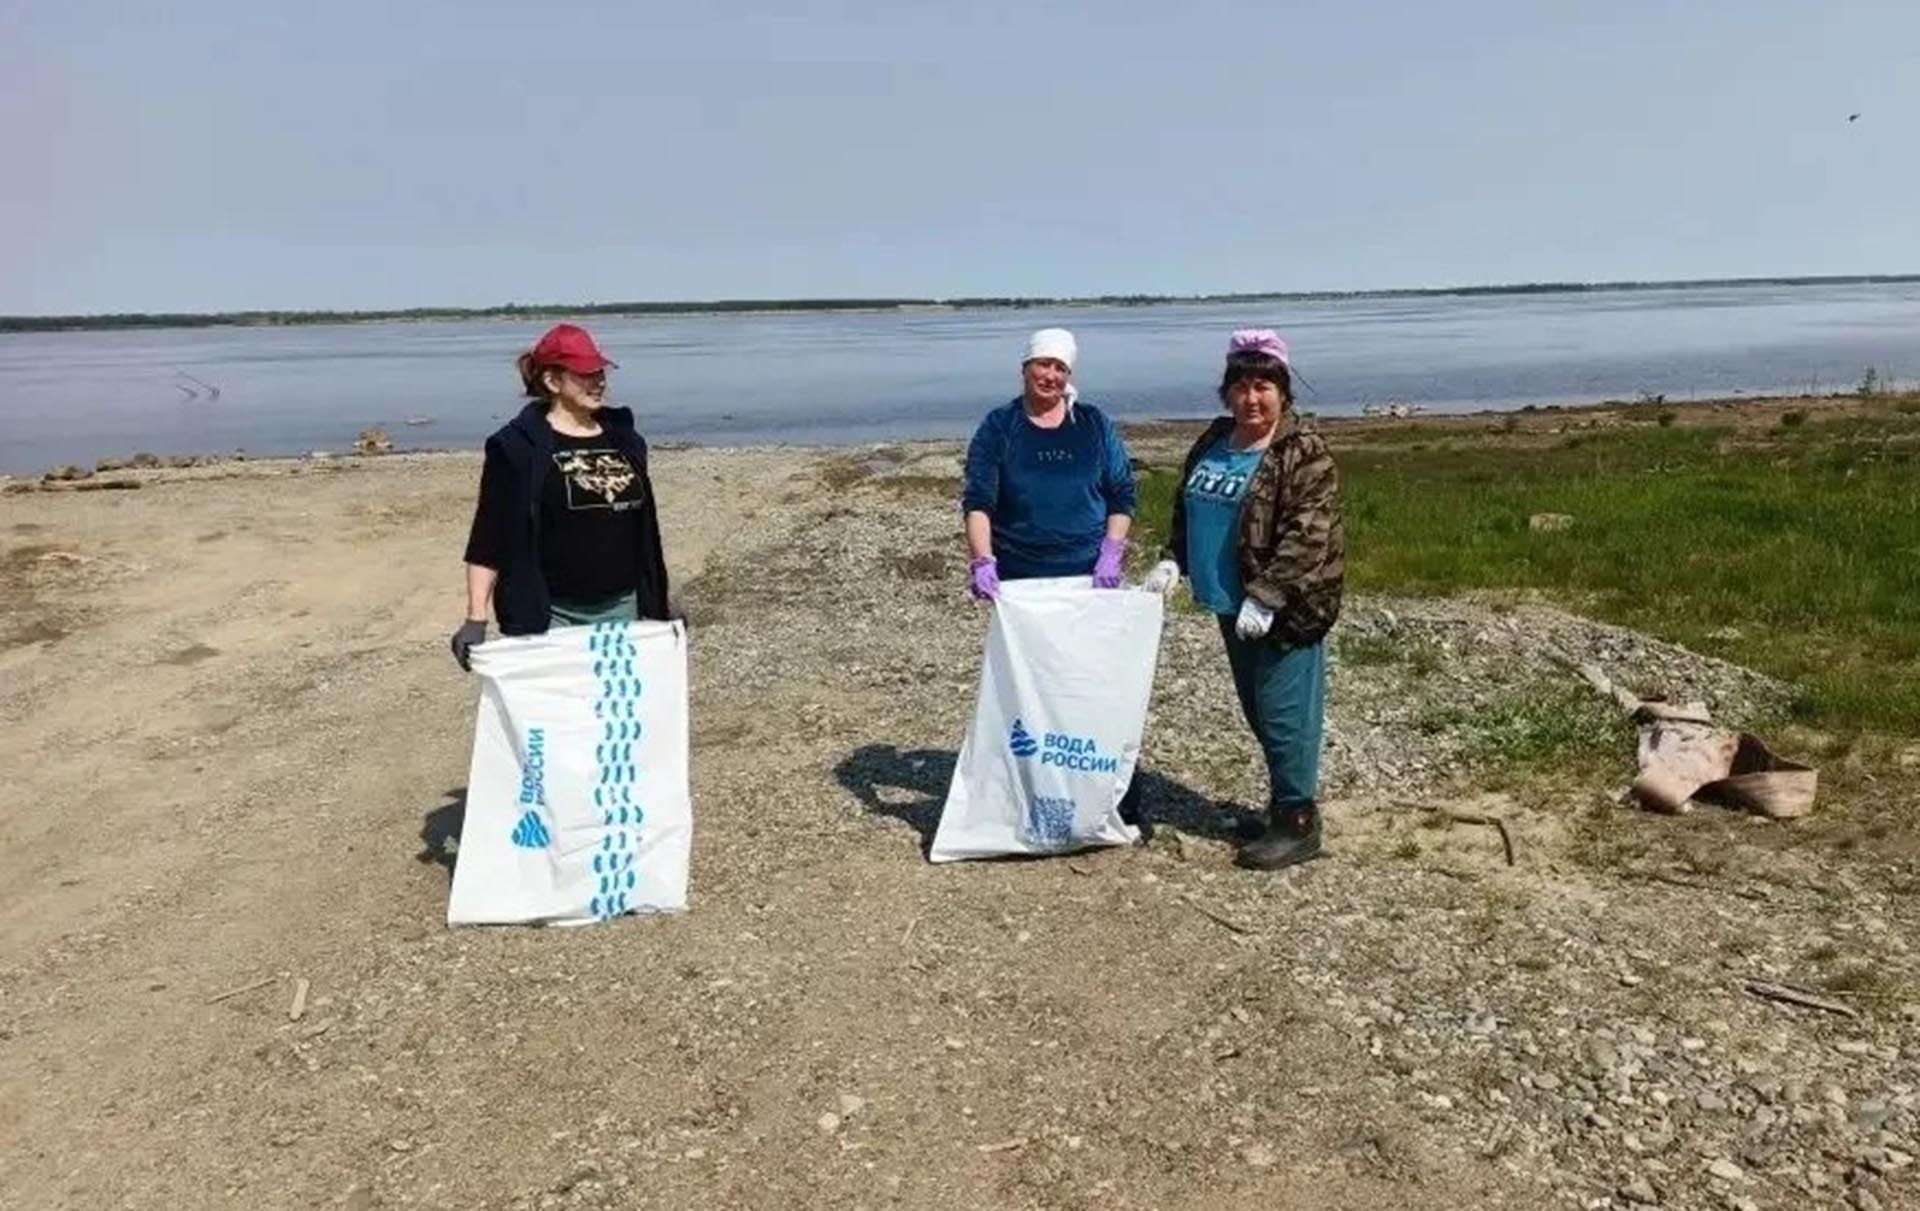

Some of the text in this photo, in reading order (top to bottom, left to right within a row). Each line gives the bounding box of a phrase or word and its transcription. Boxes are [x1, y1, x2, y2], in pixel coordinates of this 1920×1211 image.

[1043, 733, 1096, 754] ВОДА
[1041, 751, 1118, 773] РОССИИ
[519, 762, 534, 804] ВО
